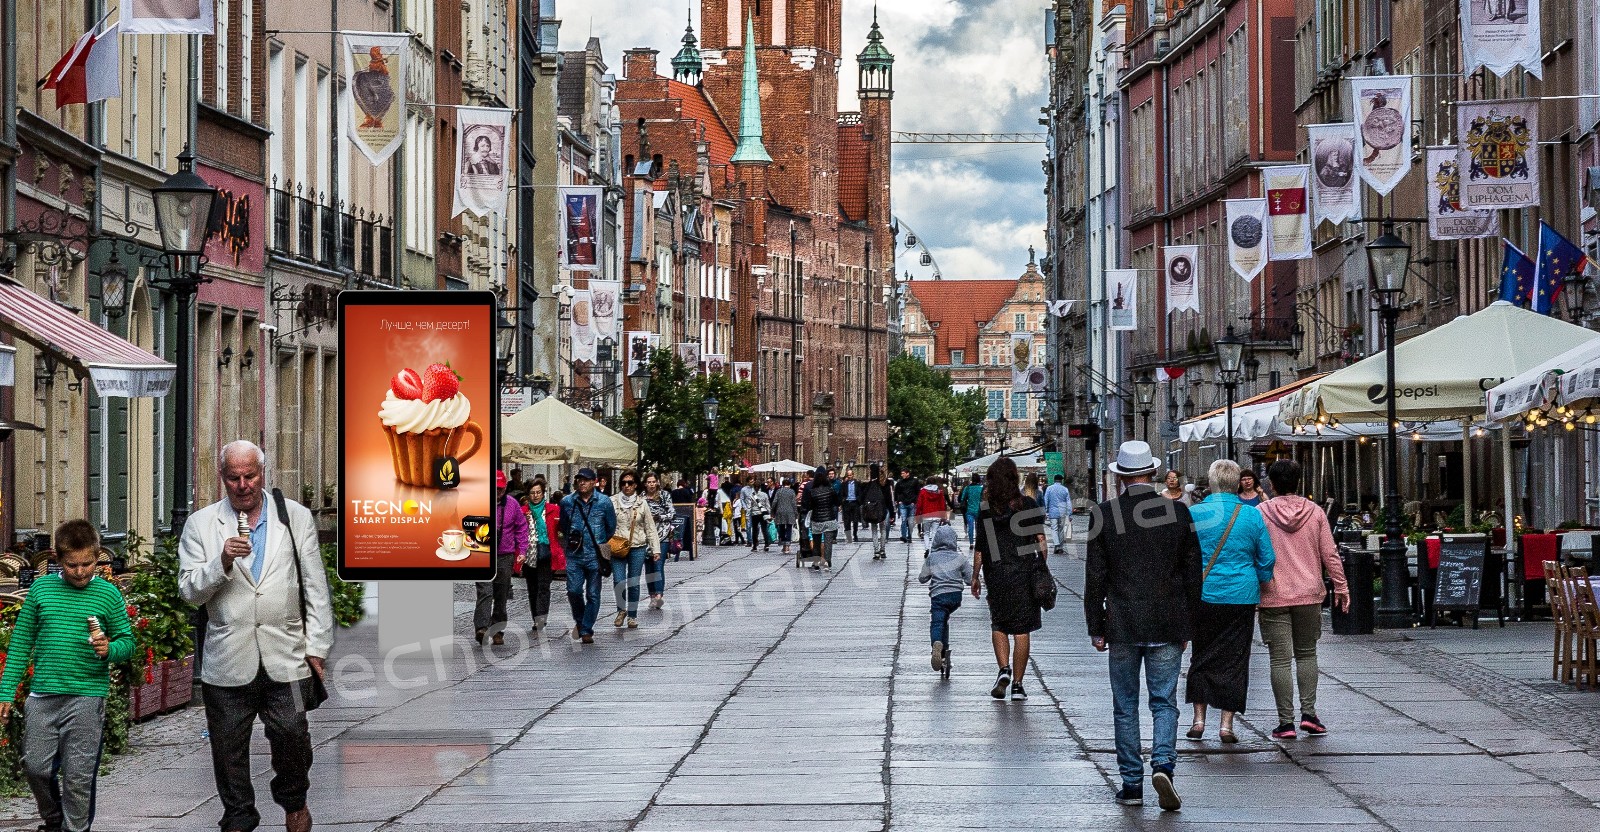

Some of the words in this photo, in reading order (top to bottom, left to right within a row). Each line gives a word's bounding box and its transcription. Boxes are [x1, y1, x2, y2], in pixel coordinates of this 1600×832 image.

[1486, 185, 1514, 195] DOM
[1469, 194, 1531, 204] UPHAGENA
[380, 319, 414, 331] Лучше,
[415, 321, 434, 330] чем
[435, 319, 470, 331] десерт!
[1394, 384, 1438, 400] pepsi
[351, 499, 432, 515] TECNON
[353, 516, 387, 524] SMART
[390, 516, 431, 524] DISPLAY
